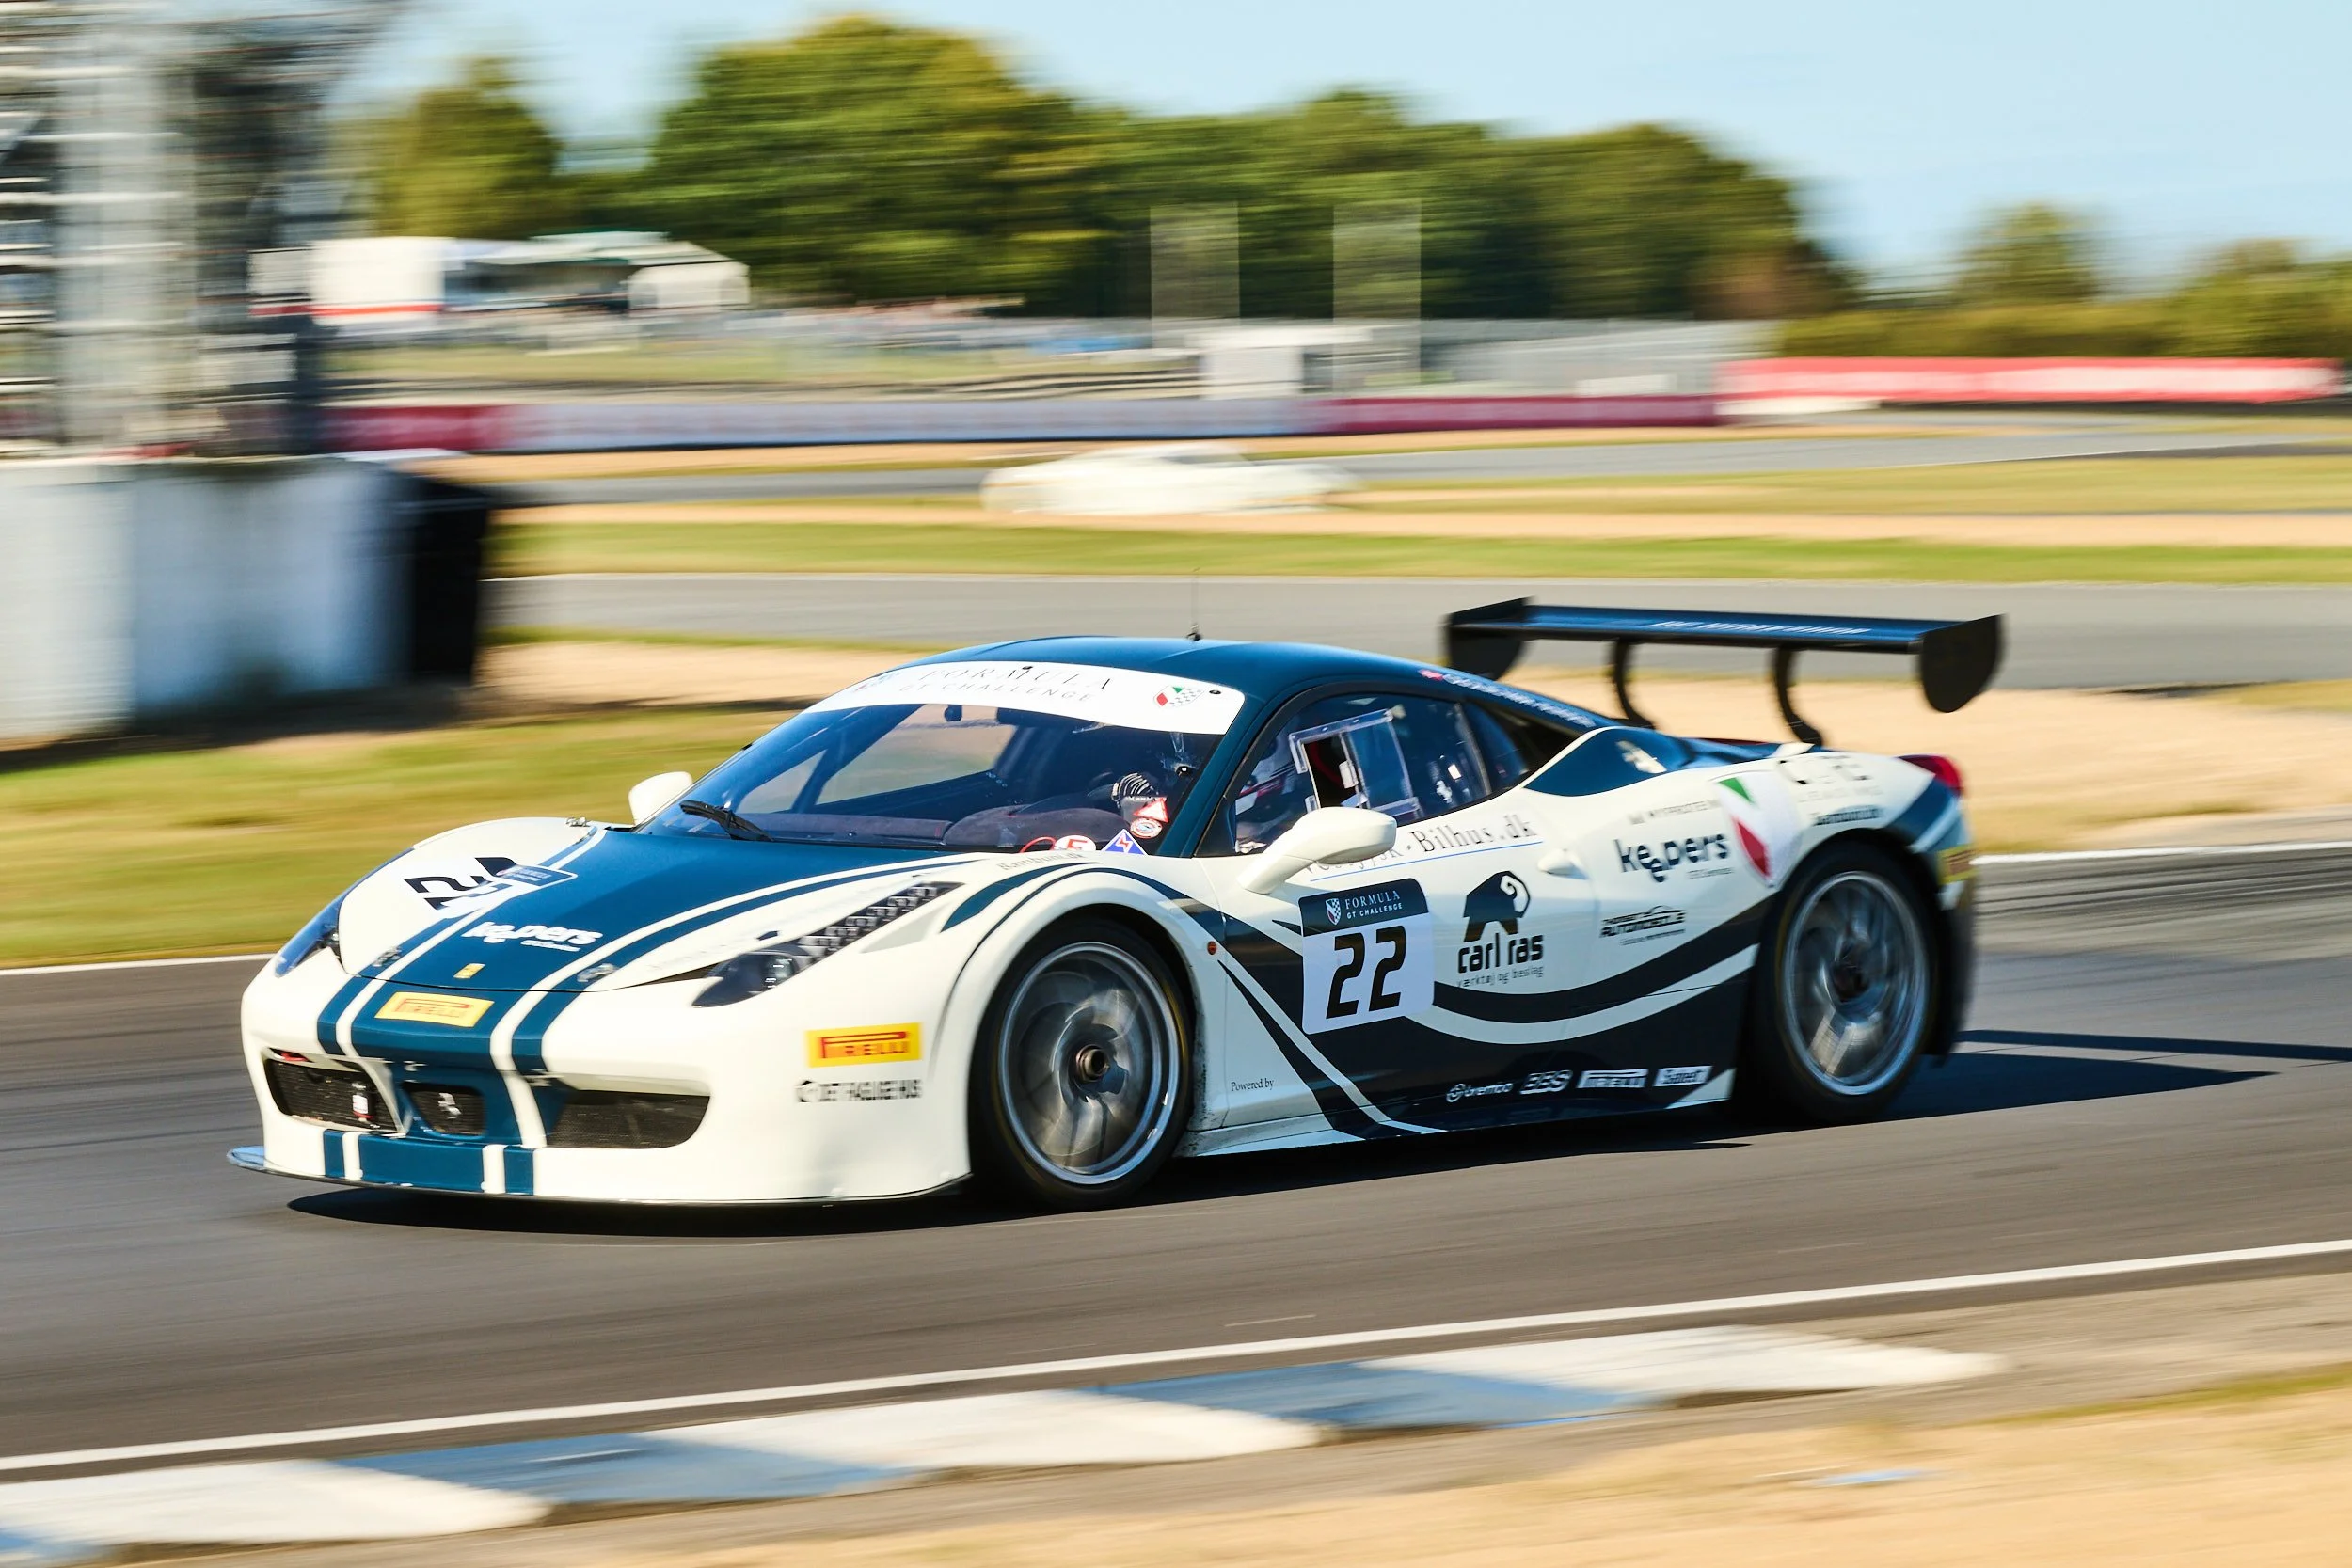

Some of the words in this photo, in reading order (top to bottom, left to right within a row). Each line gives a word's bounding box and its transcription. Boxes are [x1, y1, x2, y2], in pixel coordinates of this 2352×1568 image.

[1613, 833, 1729, 883] keepers
[1344, 890, 1401, 910] FORMULA
[1346, 911, 1357, 920] GT
[1359, 902, 1403, 917] CHALLENGE
[1458, 932, 1501, 974] carl
[1507, 934, 1544, 965] ras
[1326, 925, 1407, 1020] 22
[1497, 972, 1510, 984] og
[1511, 966, 1544, 979] beslag
[1231, 1078, 1263, 1091] Powered
[1264, 1077, 1275, 1091] by
